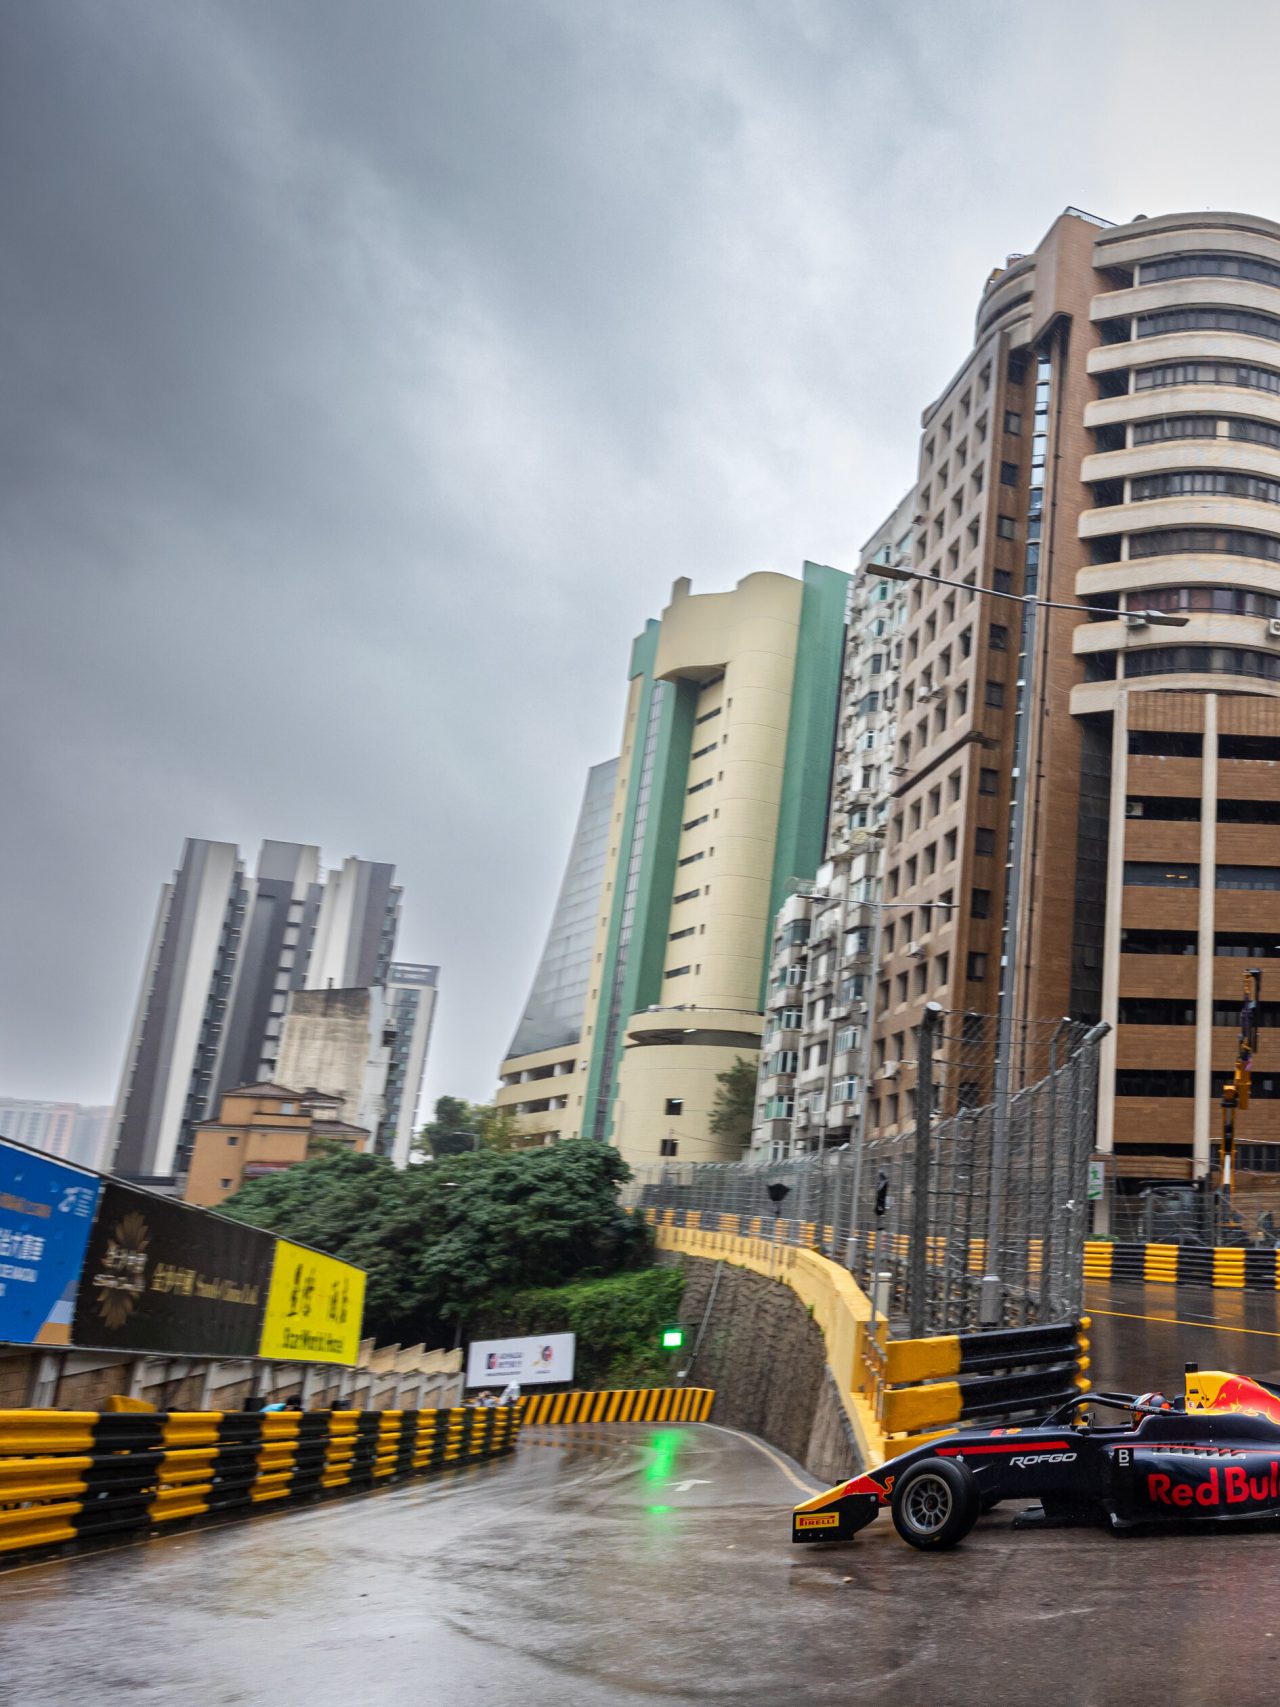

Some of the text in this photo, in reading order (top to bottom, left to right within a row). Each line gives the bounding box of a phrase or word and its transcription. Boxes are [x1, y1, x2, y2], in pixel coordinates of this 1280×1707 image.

[1009, 1453, 1077, 1468] ROFGO
[1120, 1449, 1129, 1462] B
[1147, 1467, 1220, 1506] Red
[799, 1515, 835, 1526] PIRELLI
